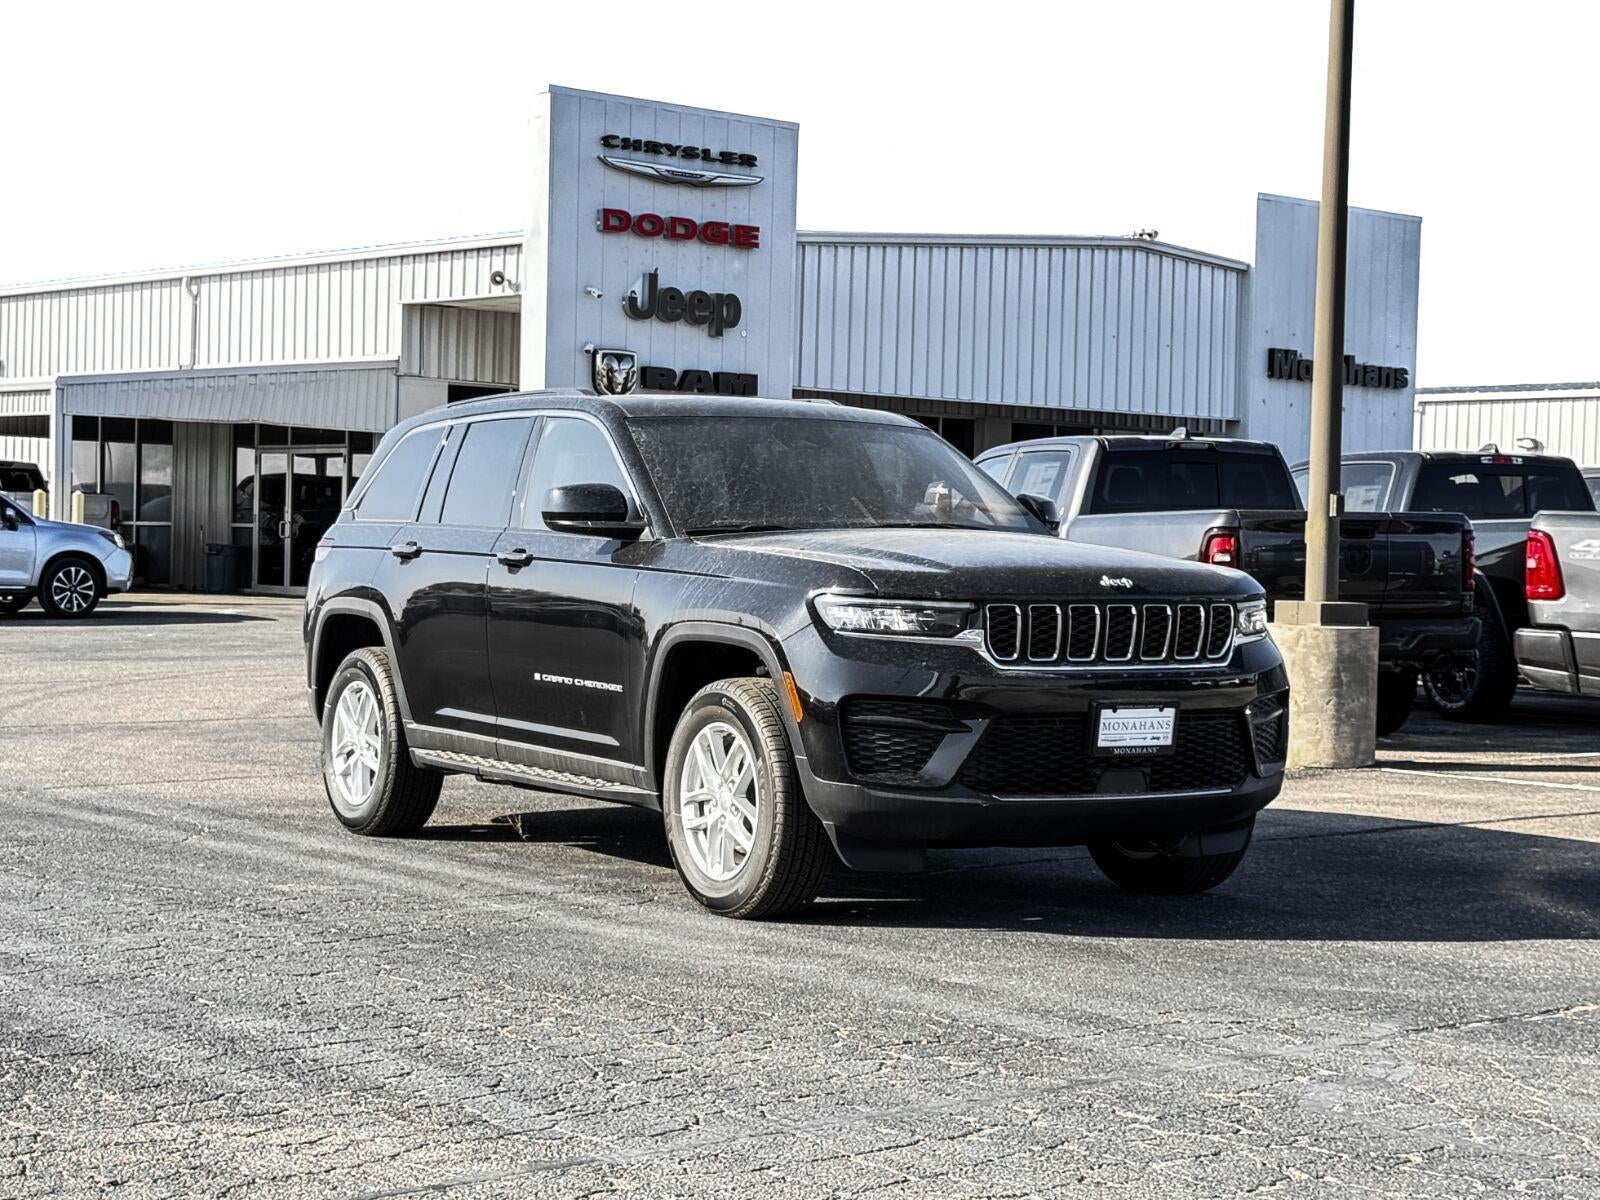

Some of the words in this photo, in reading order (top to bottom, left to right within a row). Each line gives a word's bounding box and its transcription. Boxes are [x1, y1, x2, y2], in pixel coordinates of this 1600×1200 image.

[600, 134, 758, 168] CHRYSLER
[598, 207, 760, 249] DODGE
[622, 272, 742, 338] Jeep
[640, 365, 759, 396] RAM
[1266, 347, 1409, 389] Mohans
[1100, 575, 1133, 588] Jeep
[542, 673, 573, 685] GRAND
[574, 678, 623, 692] CHEROKEE
[1102, 720, 1171, 732] MONAHANS
